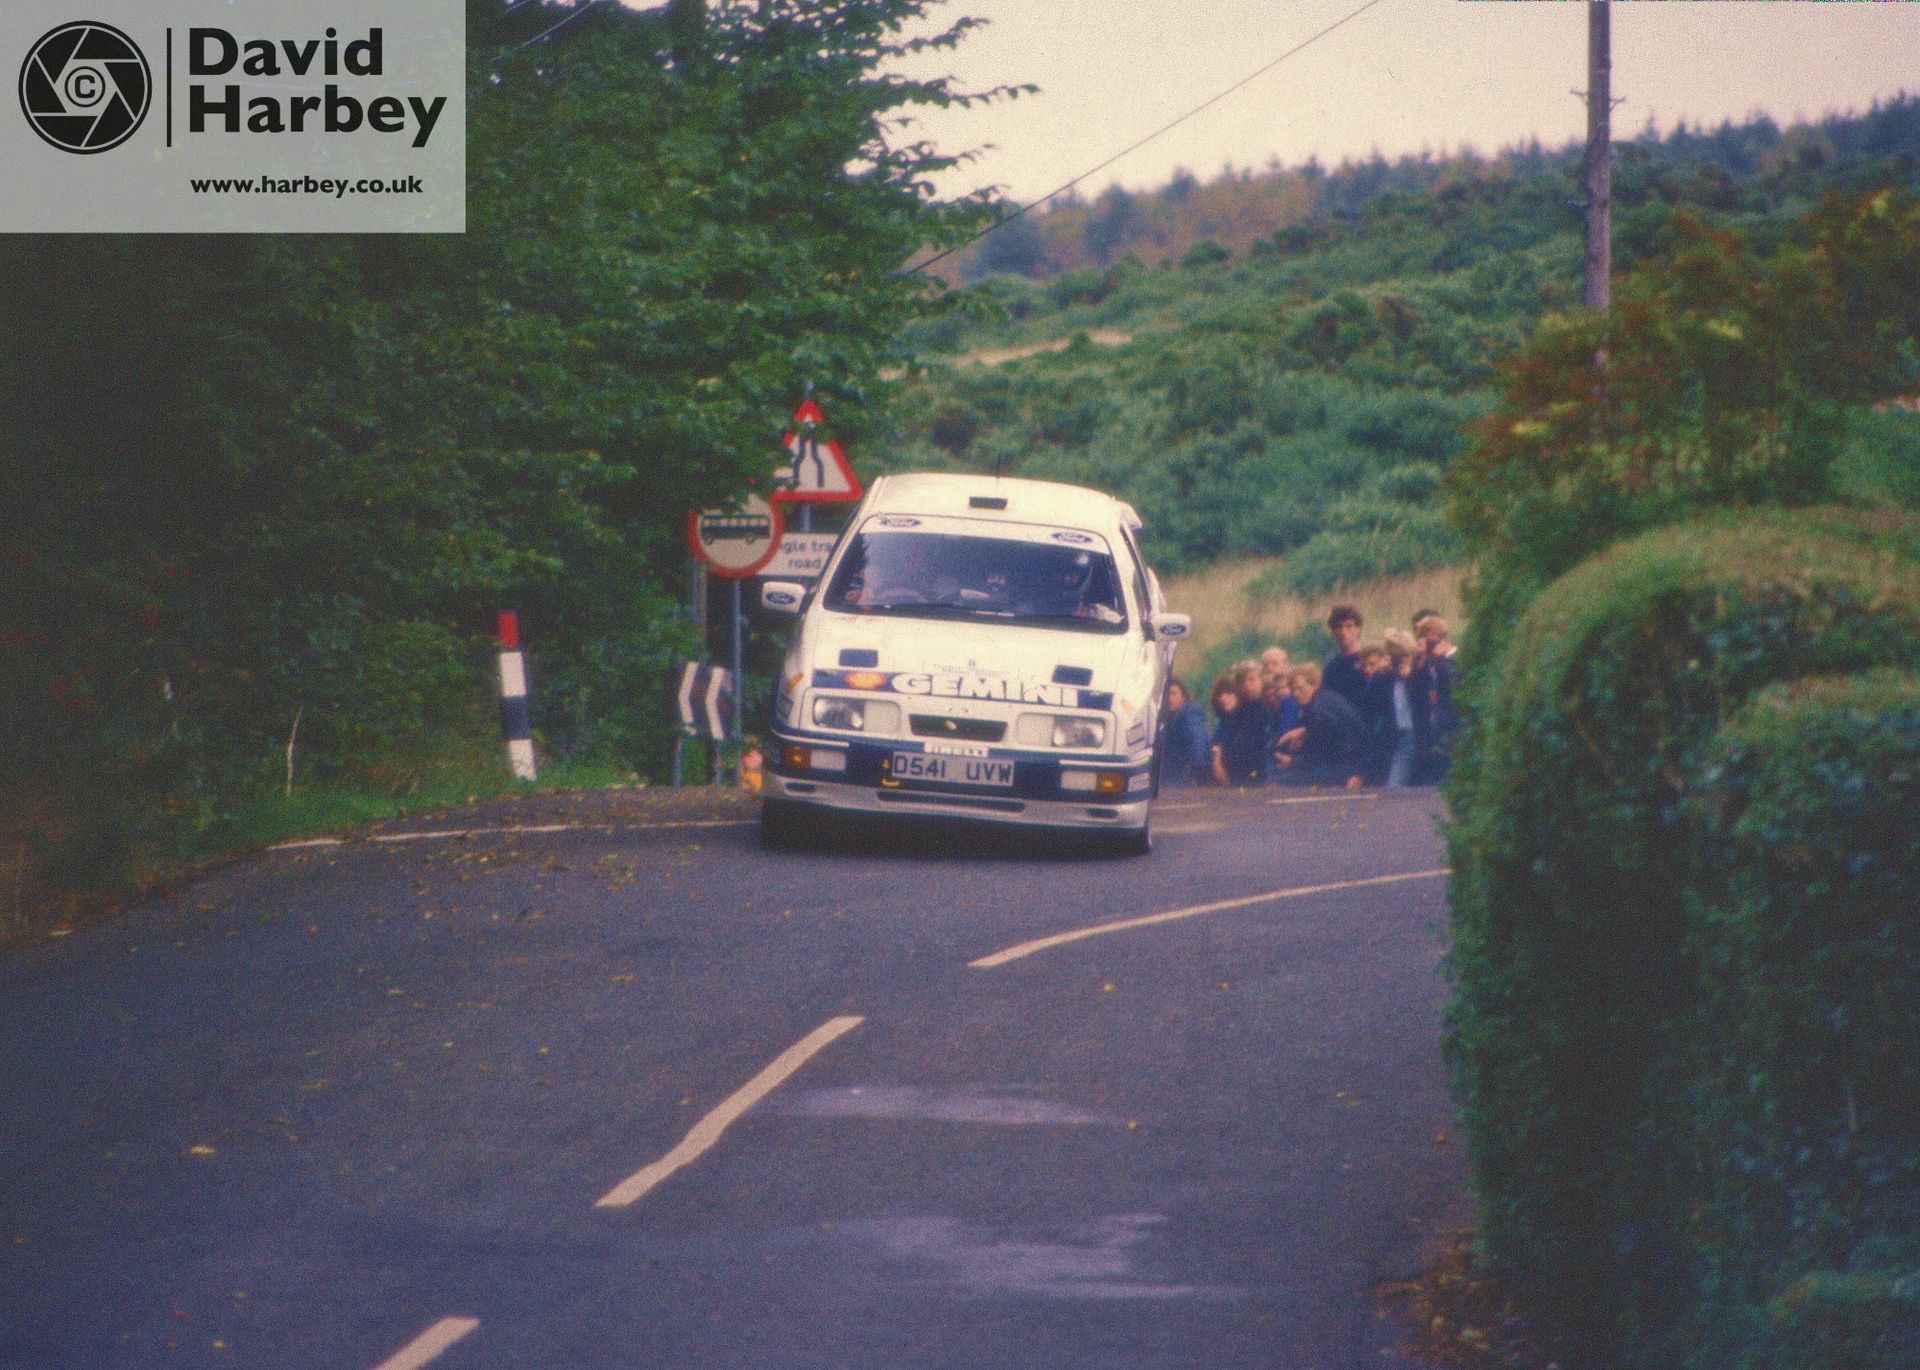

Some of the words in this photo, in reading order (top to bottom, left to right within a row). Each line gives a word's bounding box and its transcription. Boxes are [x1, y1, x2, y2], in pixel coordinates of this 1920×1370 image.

[789, 557, 821, 569] road
[891, 671, 1078, 709] GEMINI
[894, 755, 946, 777] D541
[966, 761, 1012, 783] UVW
